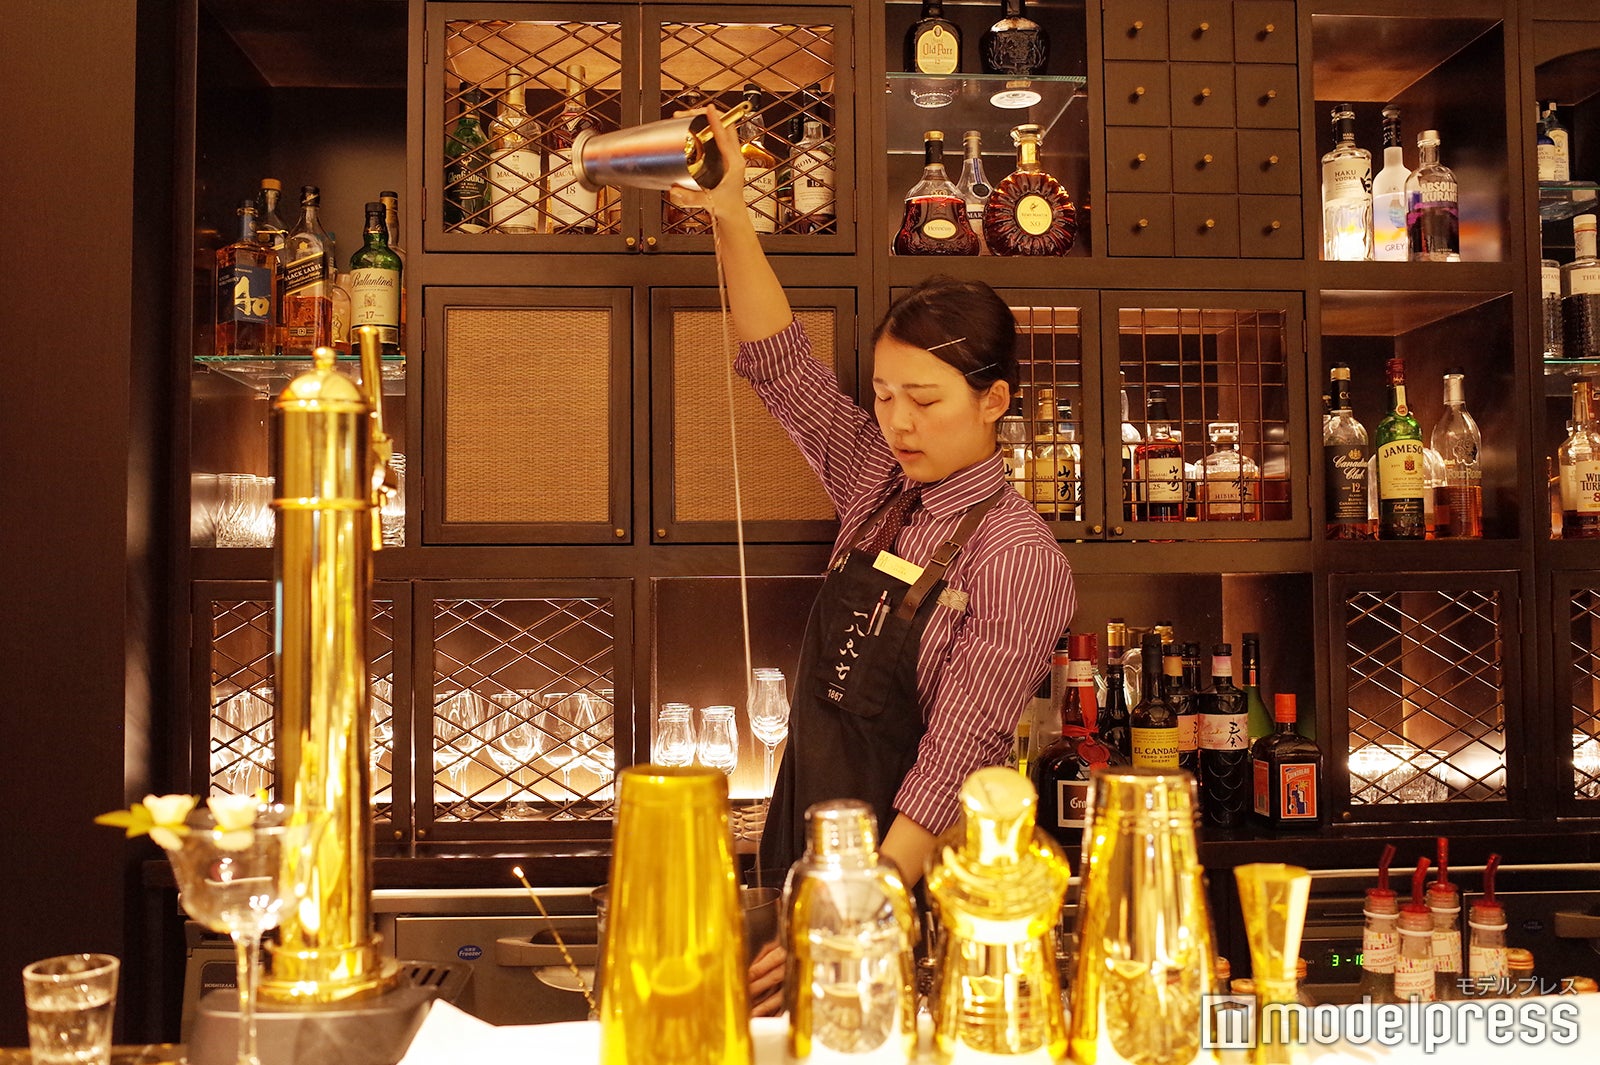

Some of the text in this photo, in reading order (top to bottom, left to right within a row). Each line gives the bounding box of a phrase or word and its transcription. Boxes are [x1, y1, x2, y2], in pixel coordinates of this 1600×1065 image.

[923, 43, 953, 56] Old Parr
[565, 186, 576, 195] 18
[1384, 243, 1406, 253] GREY
[303, 263, 323, 274] LABEL
[364, 311, 375, 319] 17
[1351, 482, 1361, 493] 12
[827, 689, 844, 702] 1867
[1134, 746, 1144, 755] EL
[1332, 954, 1341, 967] 3
